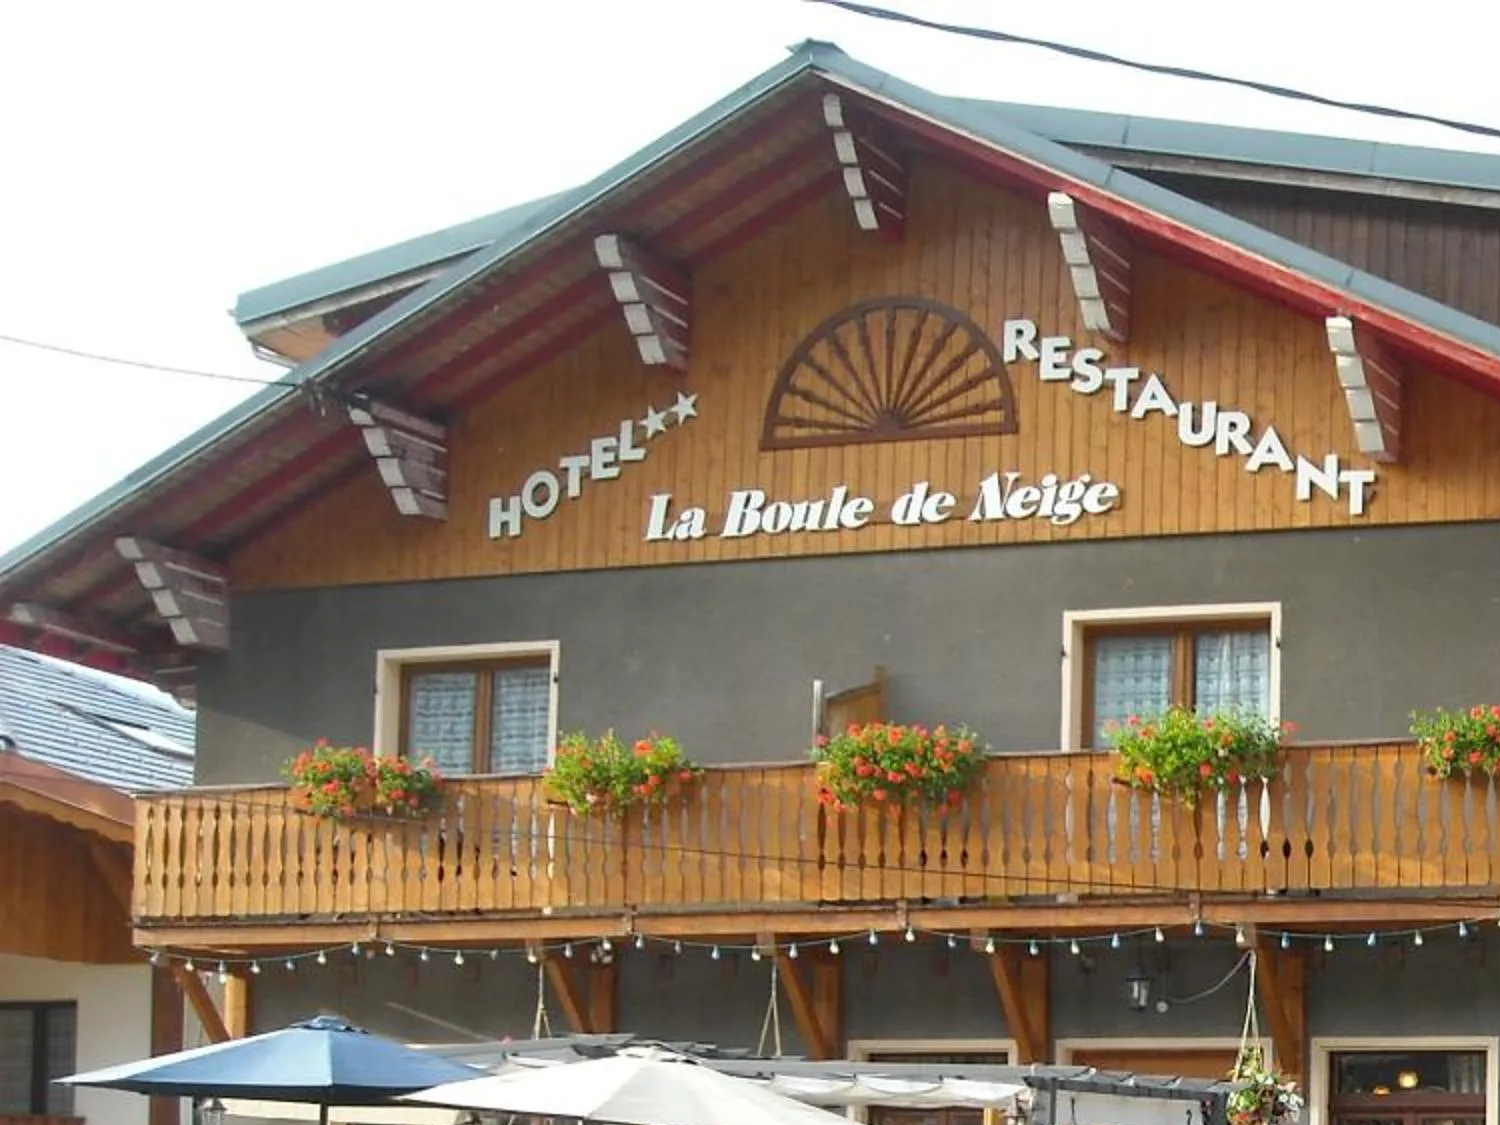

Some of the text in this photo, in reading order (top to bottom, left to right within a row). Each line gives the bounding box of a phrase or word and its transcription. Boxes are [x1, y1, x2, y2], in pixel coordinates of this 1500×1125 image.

[1003, 319, 1376, 515] RESTAURANT
[488, 419, 646, 539] HOTEL
[645, 471, 1121, 541] La Boule de Neige
